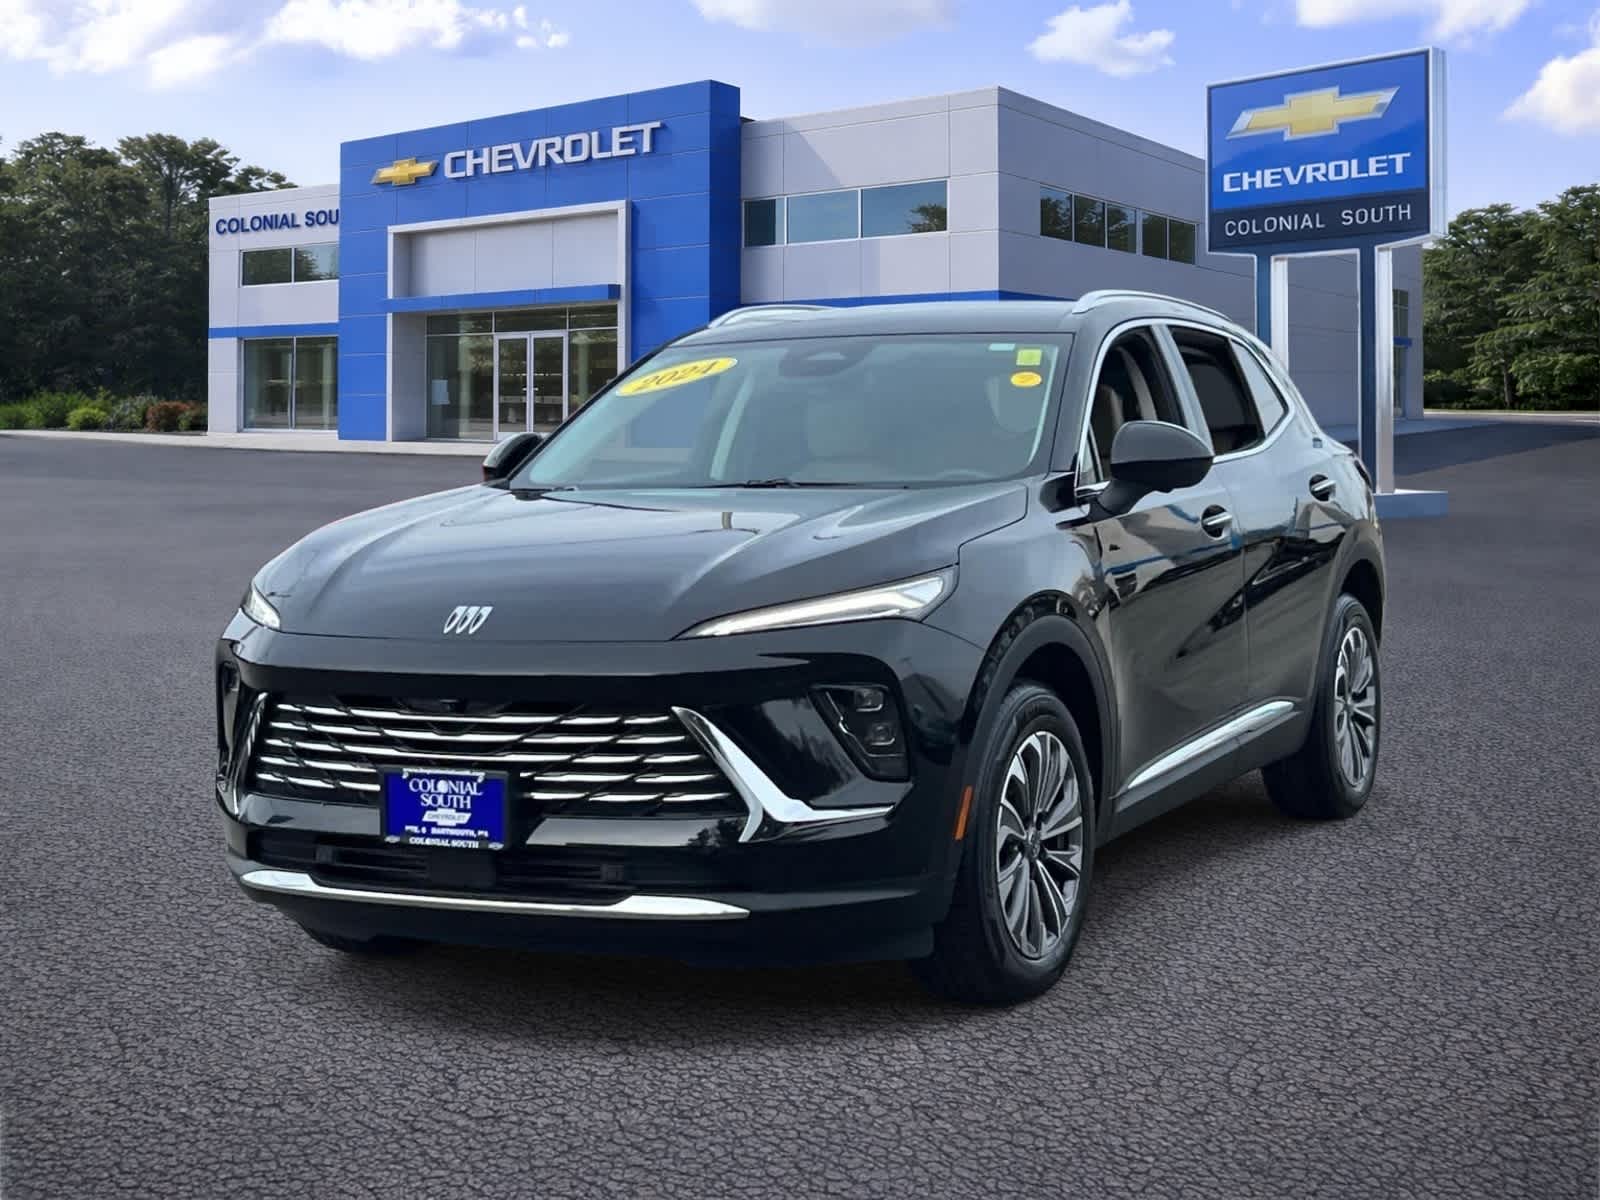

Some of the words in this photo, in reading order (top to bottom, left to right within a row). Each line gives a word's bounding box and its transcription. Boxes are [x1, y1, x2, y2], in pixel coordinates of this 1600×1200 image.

[444, 121, 662, 179] CHEVROLET
[1223, 152, 1412, 193] CHEVROLET
[215, 213, 301, 235] COLONIAL
[1224, 212, 1326, 237] COLONIAL
[1340, 204, 1412, 226] SOUTH
[408, 777, 485, 797] COLONIAL
[419, 793, 472, 809] SOUTH
